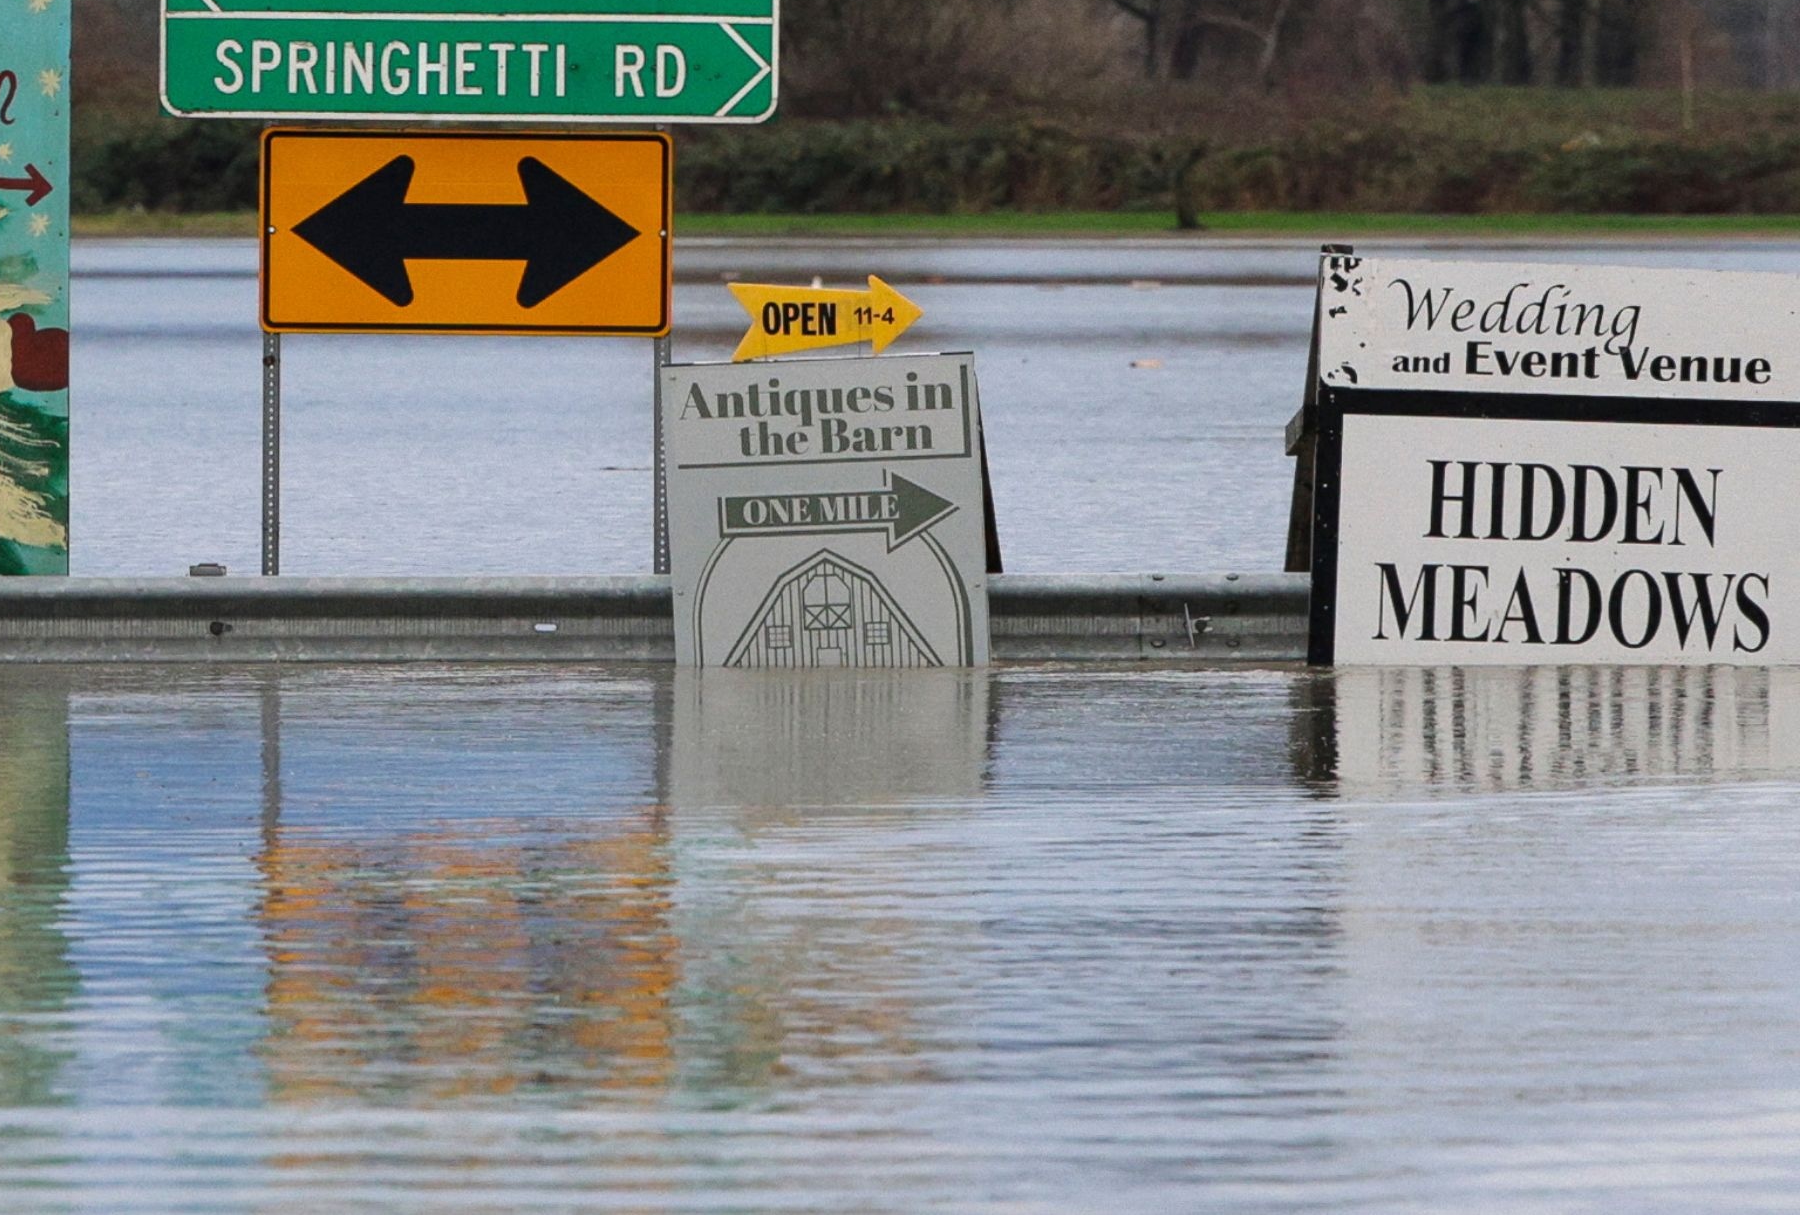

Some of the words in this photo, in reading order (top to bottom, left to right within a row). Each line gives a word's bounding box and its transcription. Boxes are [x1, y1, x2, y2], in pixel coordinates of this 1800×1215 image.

[213, 39, 567, 97] SPRINGHETTI
[614, 44, 688, 98] RD
[762, 301, 837, 336] OPEN
[853, 306, 895, 325] 11-4
[1387, 278, 1643, 356] Wedding
[1391, 351, 1452, 374] and
[1464, 341, 1601, 379] Event
[1616, 345, 1773, 384] Venue
[679, 378, 896, 427] Antiques
[906, 371, 956, 412] in
[739, 420, 809, 458] the
[818, 417, 936, 454] Barn
[742, 497, 812, 526] ONE
[816, 493, 901, 523] MILE
[1422, 459, 1724, 549] HIDDEN
[1371, 561, 1771, 653] MEADOWS
